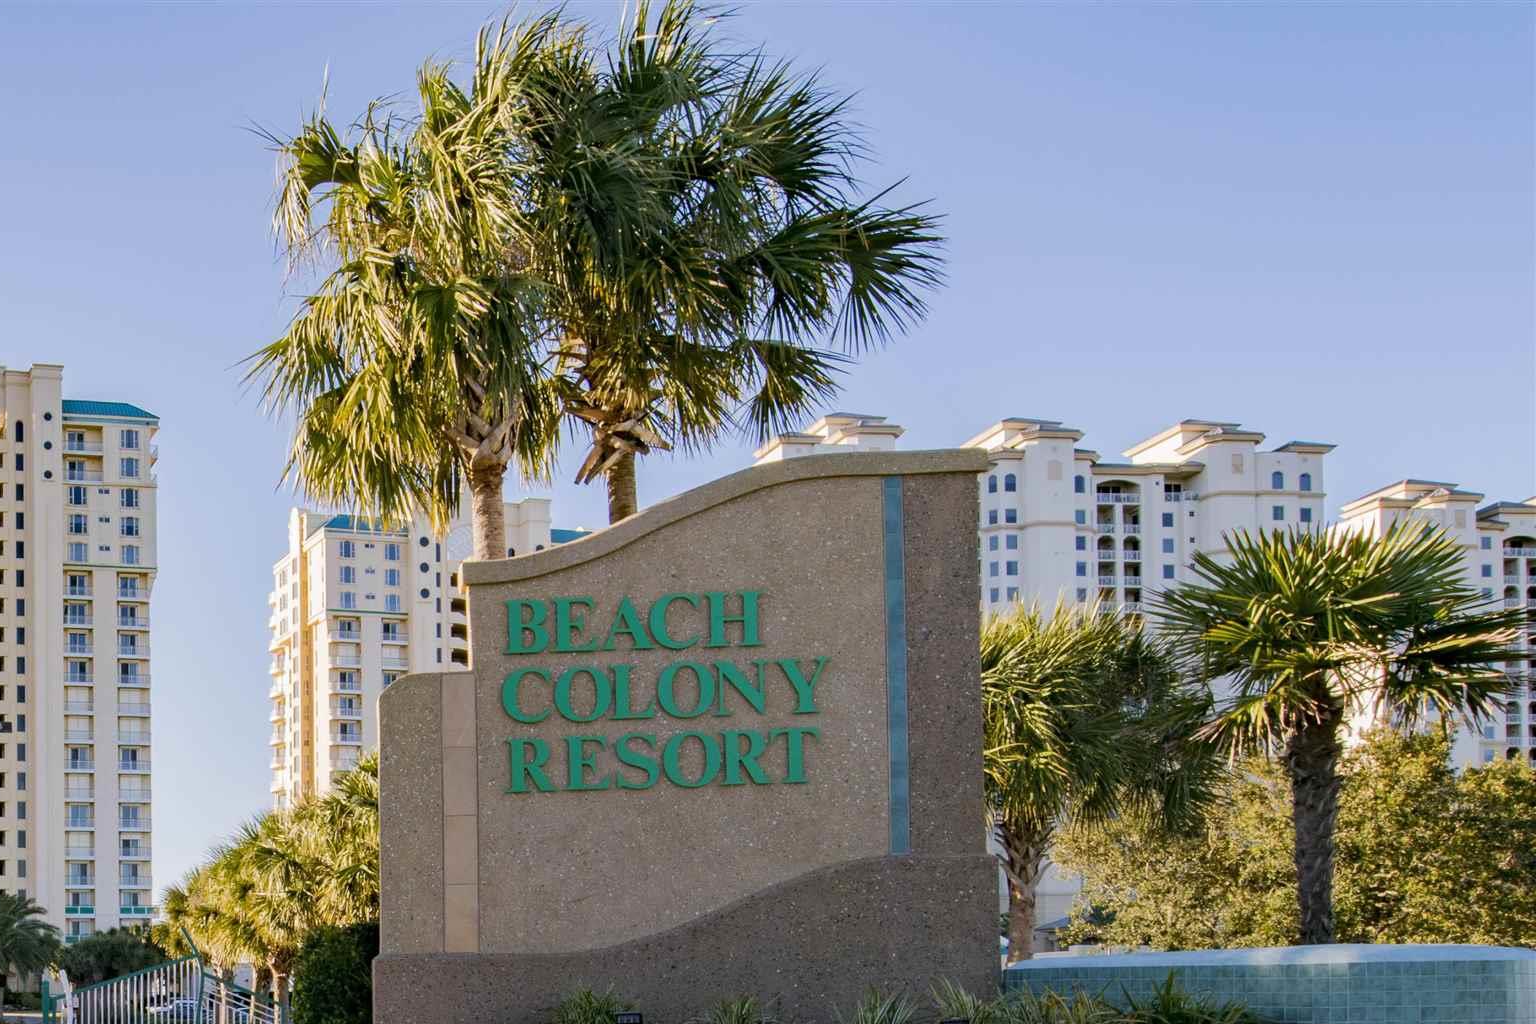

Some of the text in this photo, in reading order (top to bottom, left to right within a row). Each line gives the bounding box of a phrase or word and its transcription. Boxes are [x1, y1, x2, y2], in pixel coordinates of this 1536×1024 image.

[504, 590, 763, 655] BEACH
[501, 656, 831, 724] COLONY
[505, 727, 820, 793] RESORT
